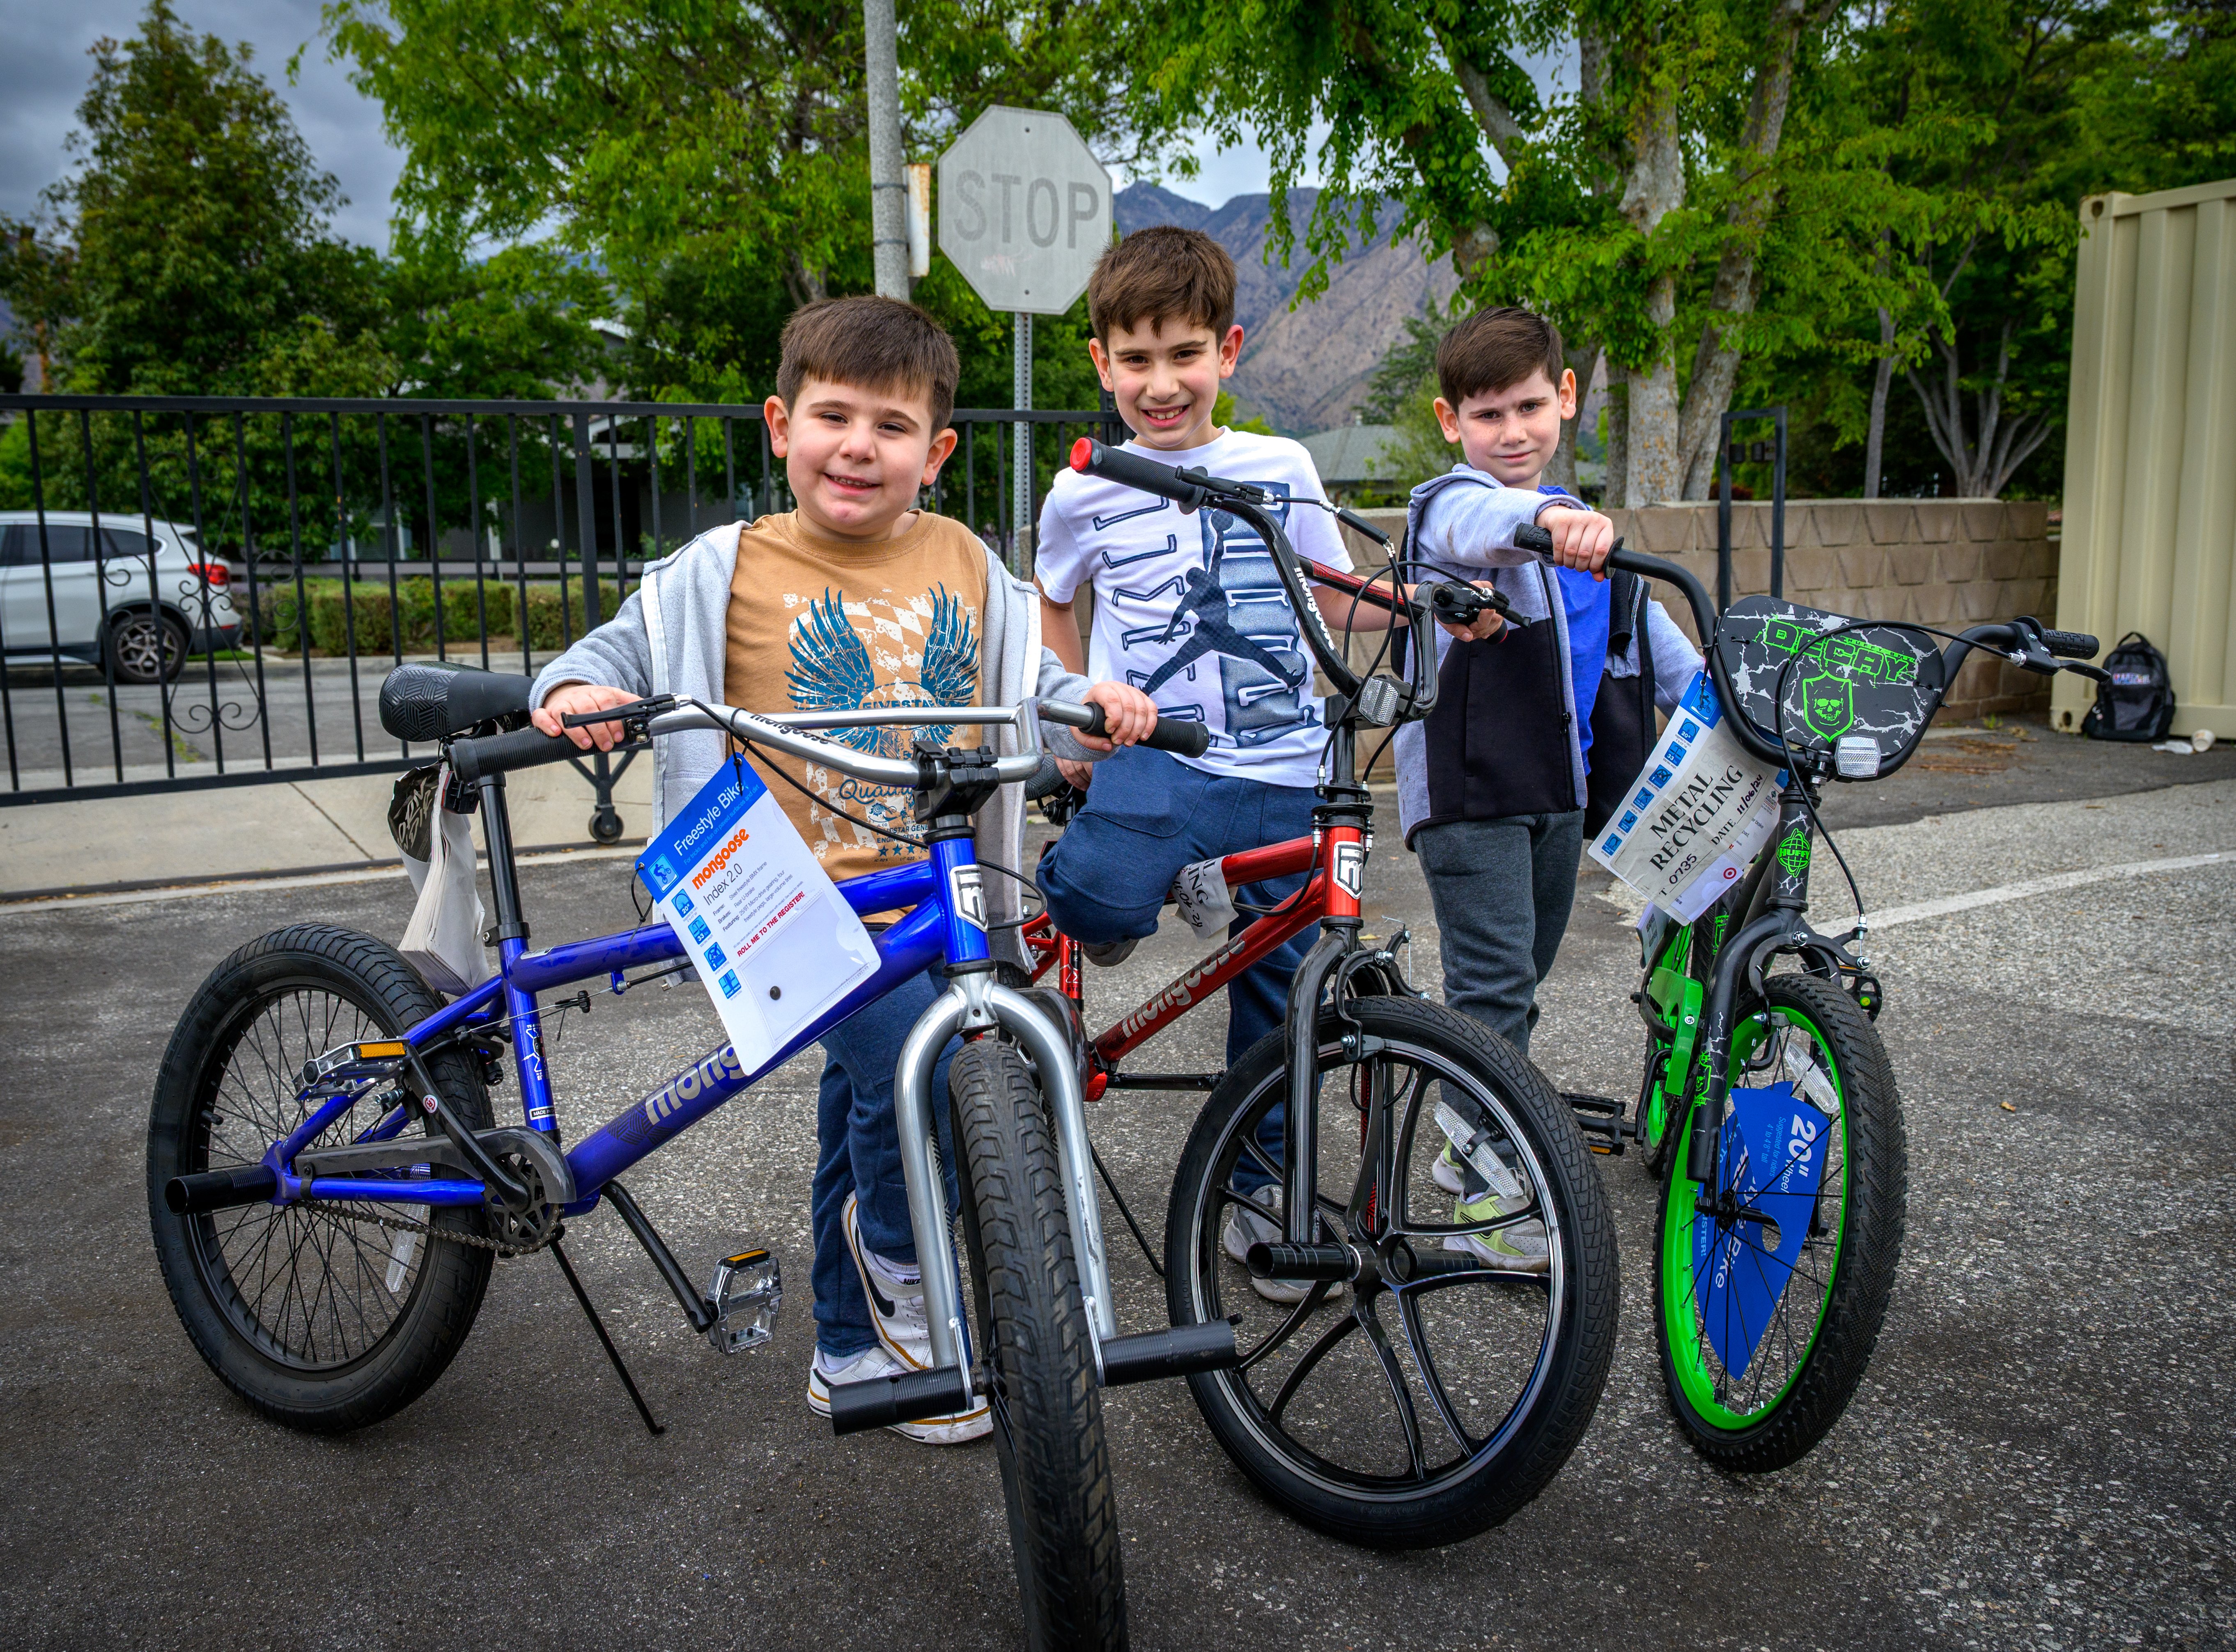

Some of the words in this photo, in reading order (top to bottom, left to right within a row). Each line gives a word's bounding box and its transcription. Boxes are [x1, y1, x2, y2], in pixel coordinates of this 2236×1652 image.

[953, 170, 1100, 250] STOP
[1294, 567, 1335, 651] mongoose
[1764, 617, 1912, 681] DECAY
[1666, 753, 1675, 761] 33
[1680, 730, 1692, 740] 20"
[673, 802, 721, 857] Freestyle
[717, 777, 745, 810] Bike
[683, 856, 692, 866] For
[689, 846, 701, 859] tricks
[699, 838, 709, 849] and
[706, 831, 715, 841] fun
[712, 826, 720, 835] on
[717, 814, 731, 829] paved
[728, 798, 746, 818] surfaces
[744, 790, 754, 801] and
[751, 783, 760, 794] dirt
[1649, 772, 1715, 840] METAL
[1649, 765, 1743, 872] RECYCLING
[1710, 819, 1736, 846] DATE
[1779, 847, 1810, 859] HUFFY
[691, 827, 750, 890] mongoose
[1669, 854, 1697, 884] 0735
[702, 876, 729, 906] Index
[725, 862, 743, 883] 2.0
[712, 902, 725, 917] Frame:
[728, 889, 738, 901] Steel
[736, 876, 751, 893] freestyle
[748, 869, 758, 880] BMX
[757, 860, 767, 872] frame
[717, 909, 731, 925] Brakes:
[734, 897, 743, 909] Rear
[741, 885, 755, 901] U-brake
[722, 913, 740, 933] Featuring:
[747, 887, 766, 908] Micro-drive
[764, 875, 779, 891] gearing,
[777, 869, 785, 879] four
[744, 907, 758, 924] freestyle
[764, 879, 786, 903] large-volume
[784, 873, 793, 883] tires
[680, 903, 691, 915] 20"
[736, 942, 751, 957] ROLL
[750, 933, 760, 945] ME
[759, 926, 768, 936] TO
[767, 915, 779, 929] THE
[777, 890, 805, 919] REGISTER!
[696, 932, 705, 942] 33
[726, 989, 735, 998] STUNT
[1123, 939, 1246, 1038] mongoose
[645, 1040, 746, 1126] mong
[1774, 1117, 1786, 1150] Suggested
[1788, 1114, 1816, 1178] 20"
[1761, 1153, 1769, 1163] tall
[1769, 1161, 1778, 1177] riders
[1780, 1156, 1798, 1193] Wheel
[1181, 1279, 1191, 1312] NYLON
[211, 1327, 223, 1339] 280
